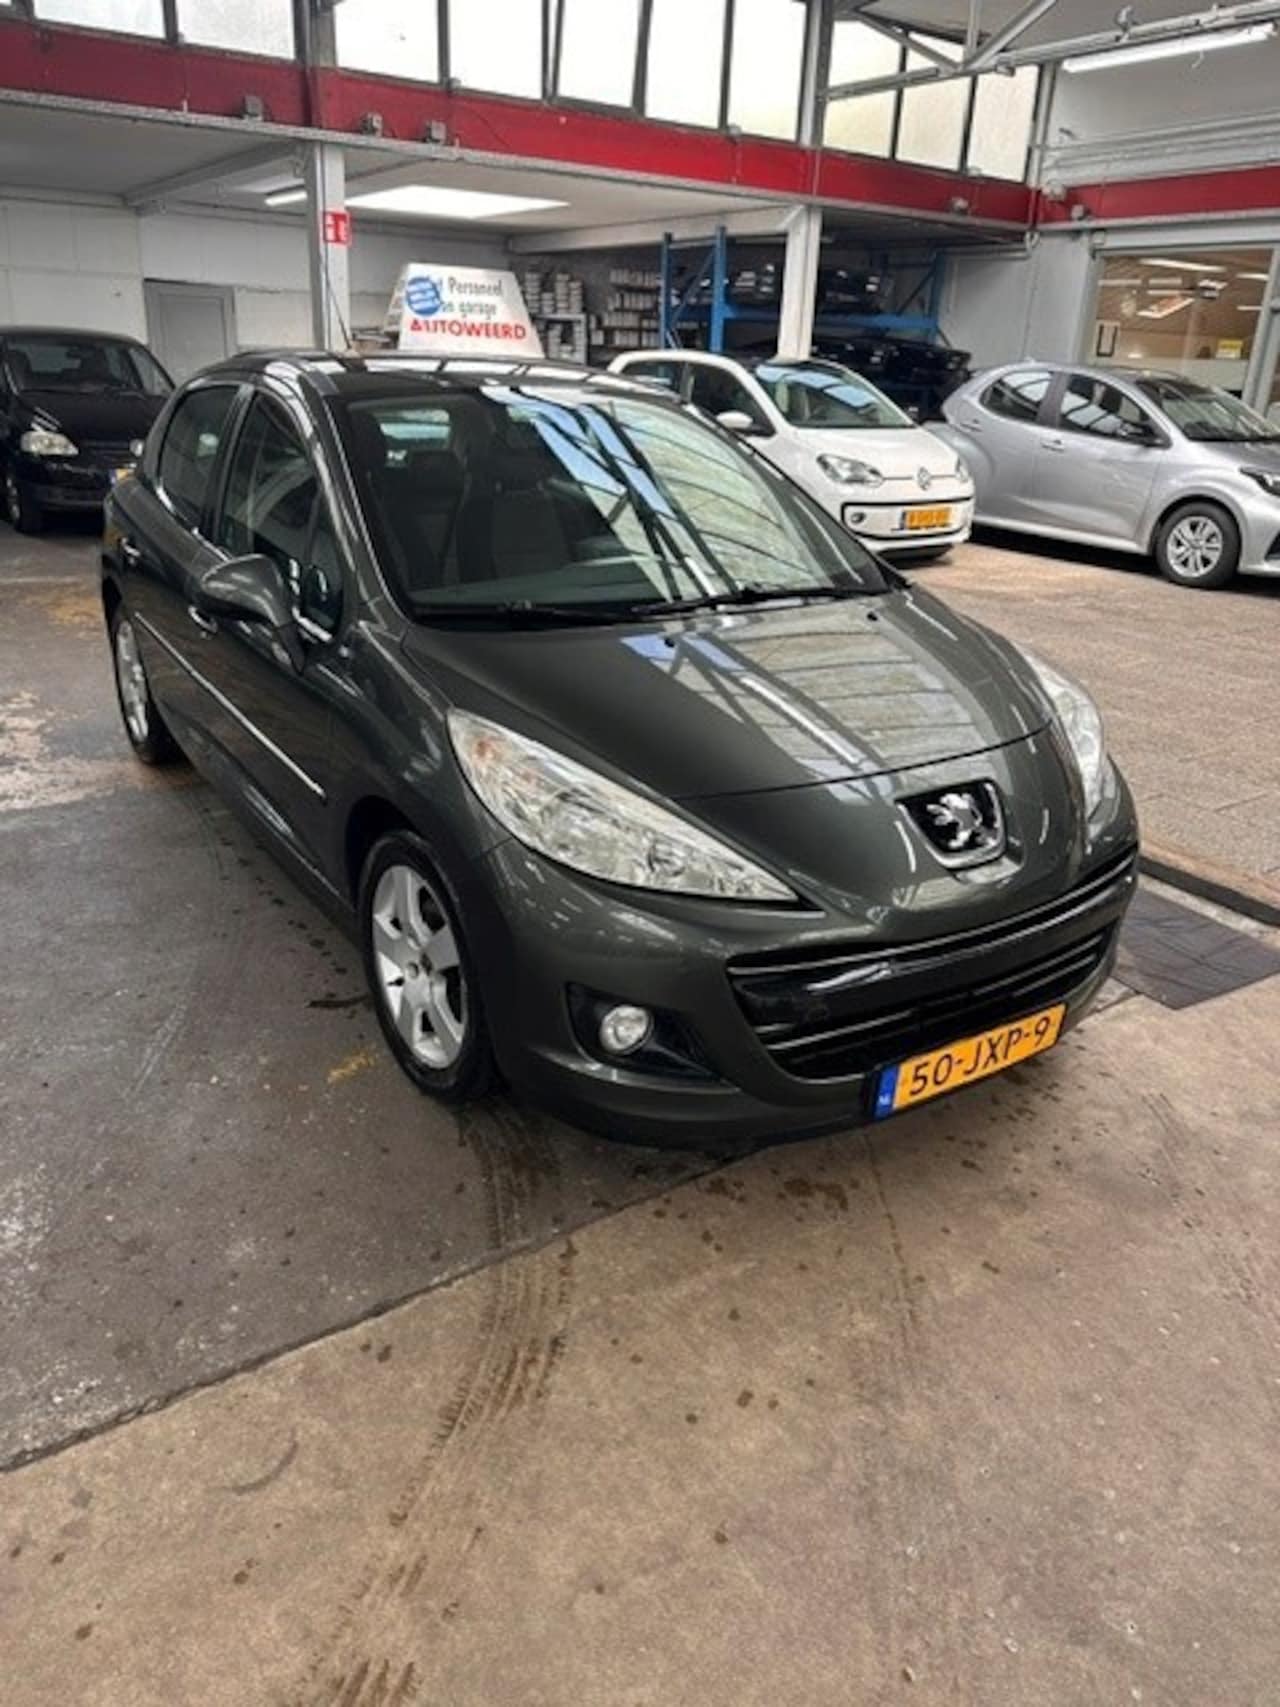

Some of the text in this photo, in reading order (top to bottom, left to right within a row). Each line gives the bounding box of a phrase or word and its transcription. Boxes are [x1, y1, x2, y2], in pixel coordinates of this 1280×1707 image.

[459, 302, 497, 320] garage
[410, 318, 526, 339] AUTOWEERD
[909, 1016, 1051, 1096] 50-JXP-9
